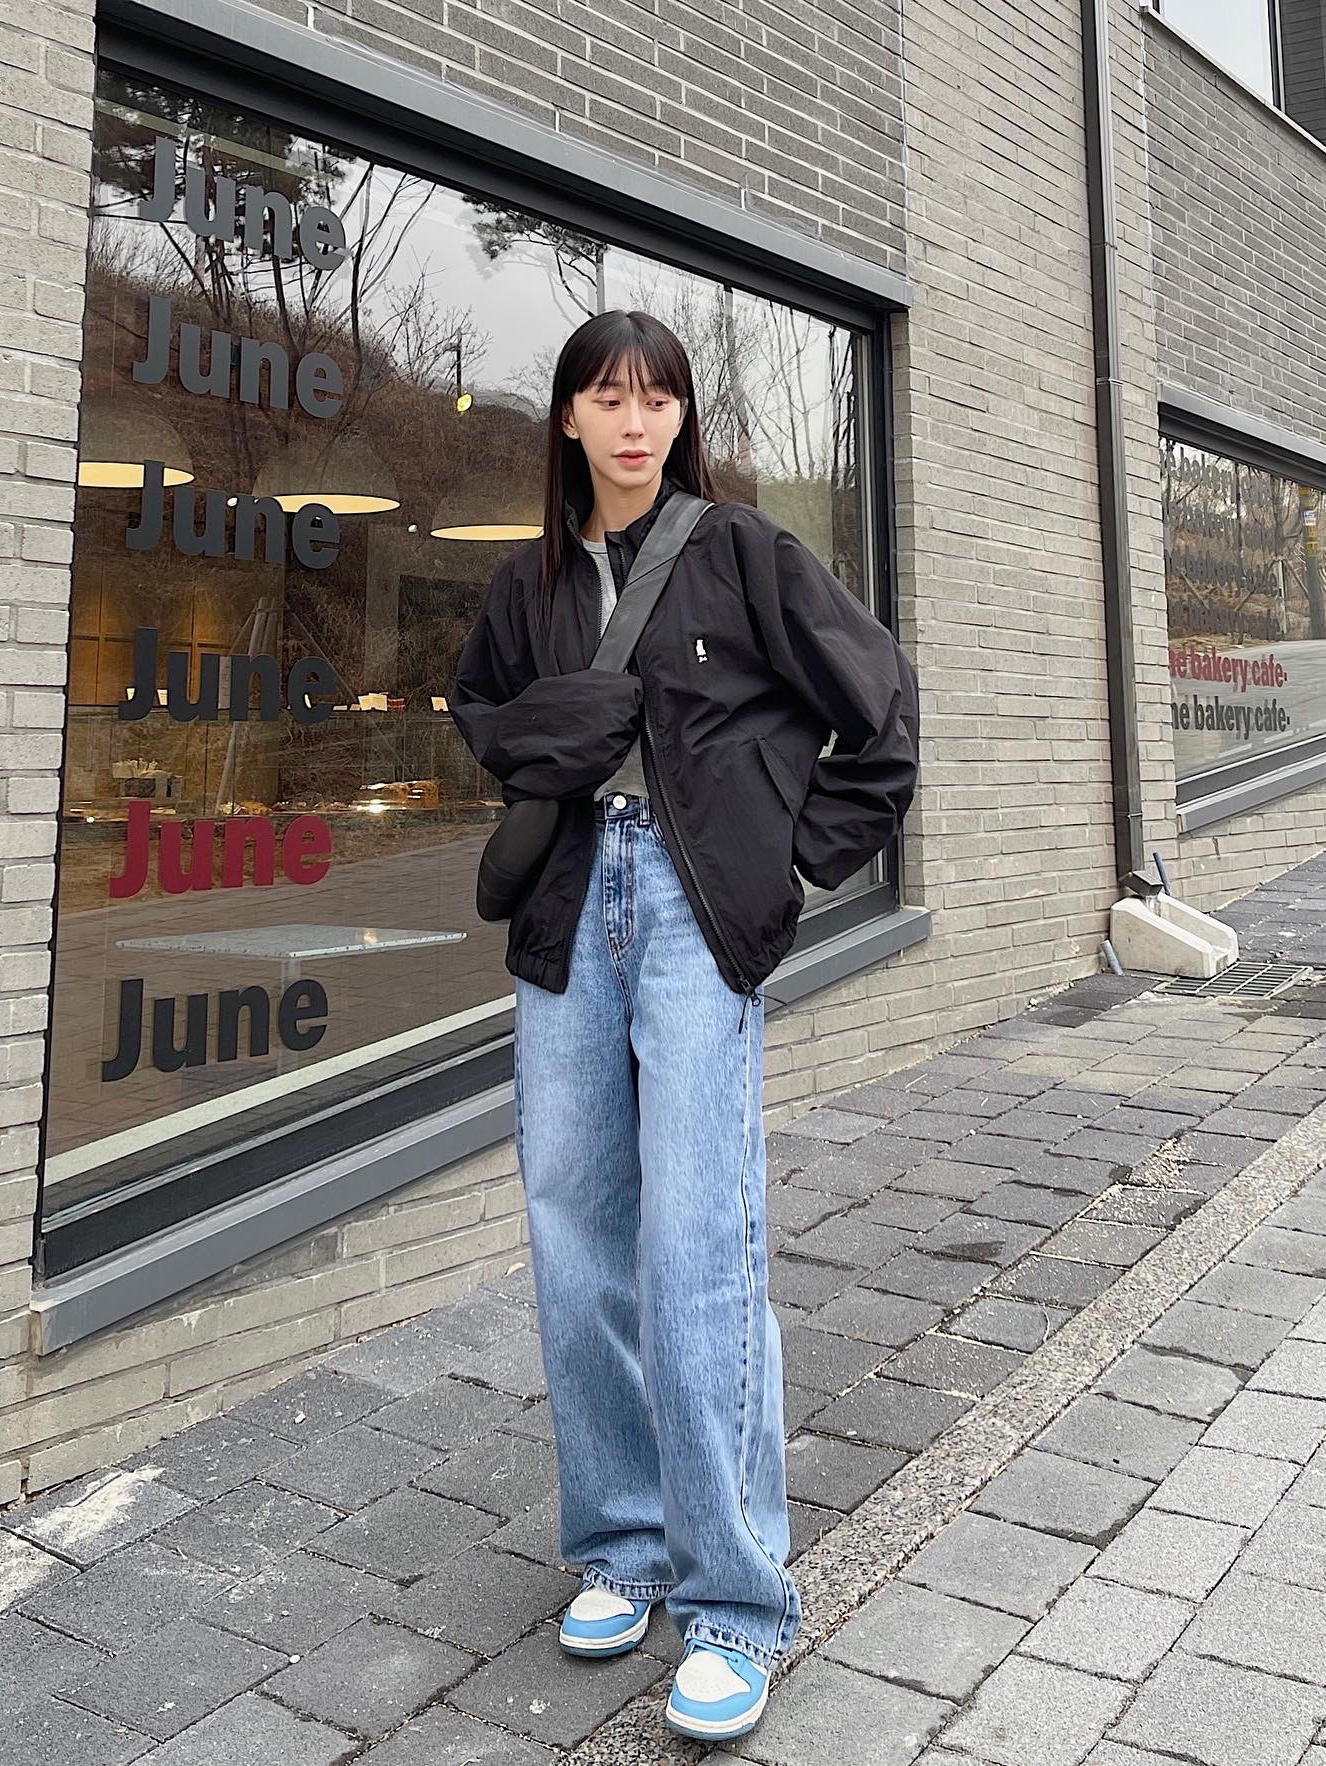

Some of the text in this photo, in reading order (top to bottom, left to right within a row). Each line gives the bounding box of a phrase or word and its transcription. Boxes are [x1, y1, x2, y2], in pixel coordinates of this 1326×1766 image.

[140, 136, 345, 270] June
[132, 296, 343, 418] June
[126, 459, 340, 569] June
[118, 626, 336, 723] June
[1190, 645, 1248, 693] bakery
[1193, 694, 1251, 740] bakery
[109, 800, 332, 898] June
[102, 978, 328, 1082] June
